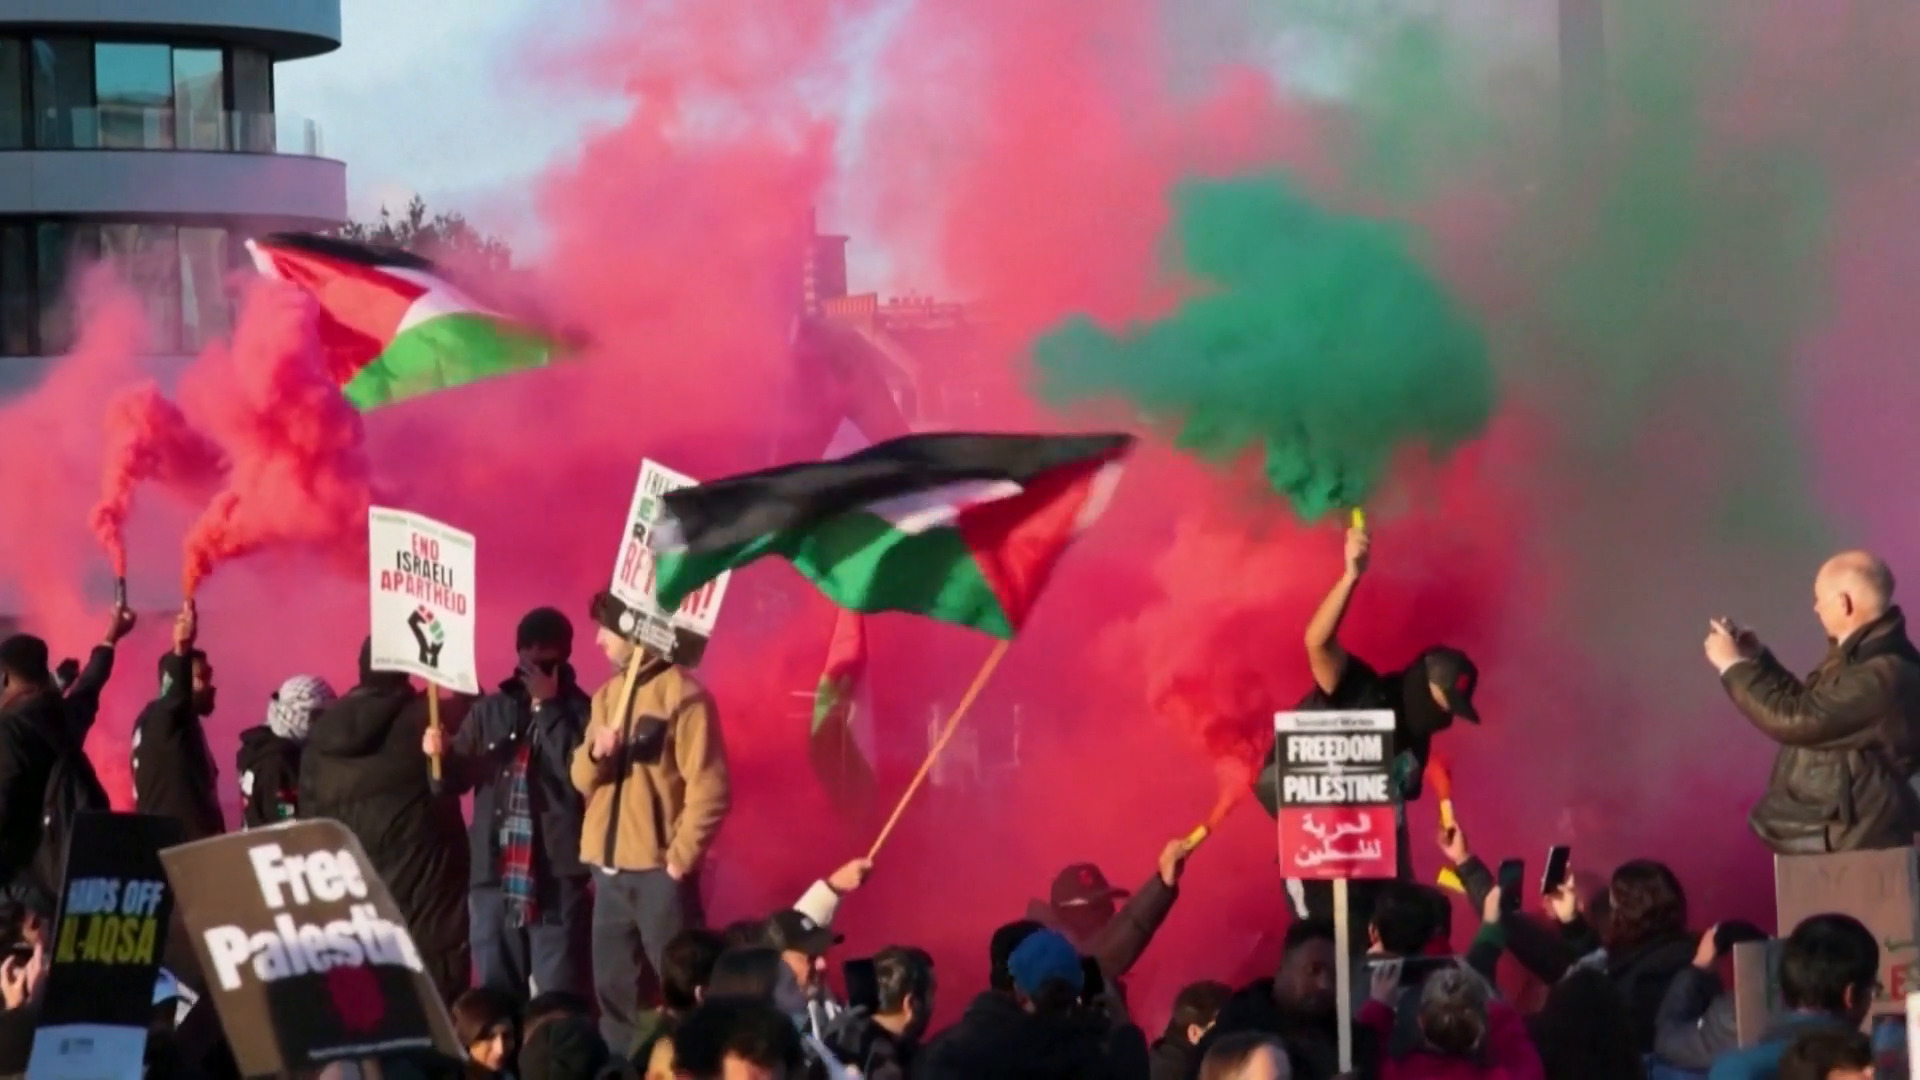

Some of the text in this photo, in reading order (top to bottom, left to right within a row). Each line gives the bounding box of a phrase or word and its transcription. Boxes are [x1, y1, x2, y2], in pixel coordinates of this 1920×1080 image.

[411, 532, 440, 561] END
[396, 549, 453, 589] ISRAELI
[380, 570, 467, 616] APARTHEID
[1287, 734, 1382, 763] FREEDOM
[1283, 774, 1389, 803] PALESTINE
[1302, 812, 1372, 842] الحرية
[1294, 836, 1382, 868] لفلسطين
[248, 842, 368, 908] Free
[122, 879, 164, 917] OFF
